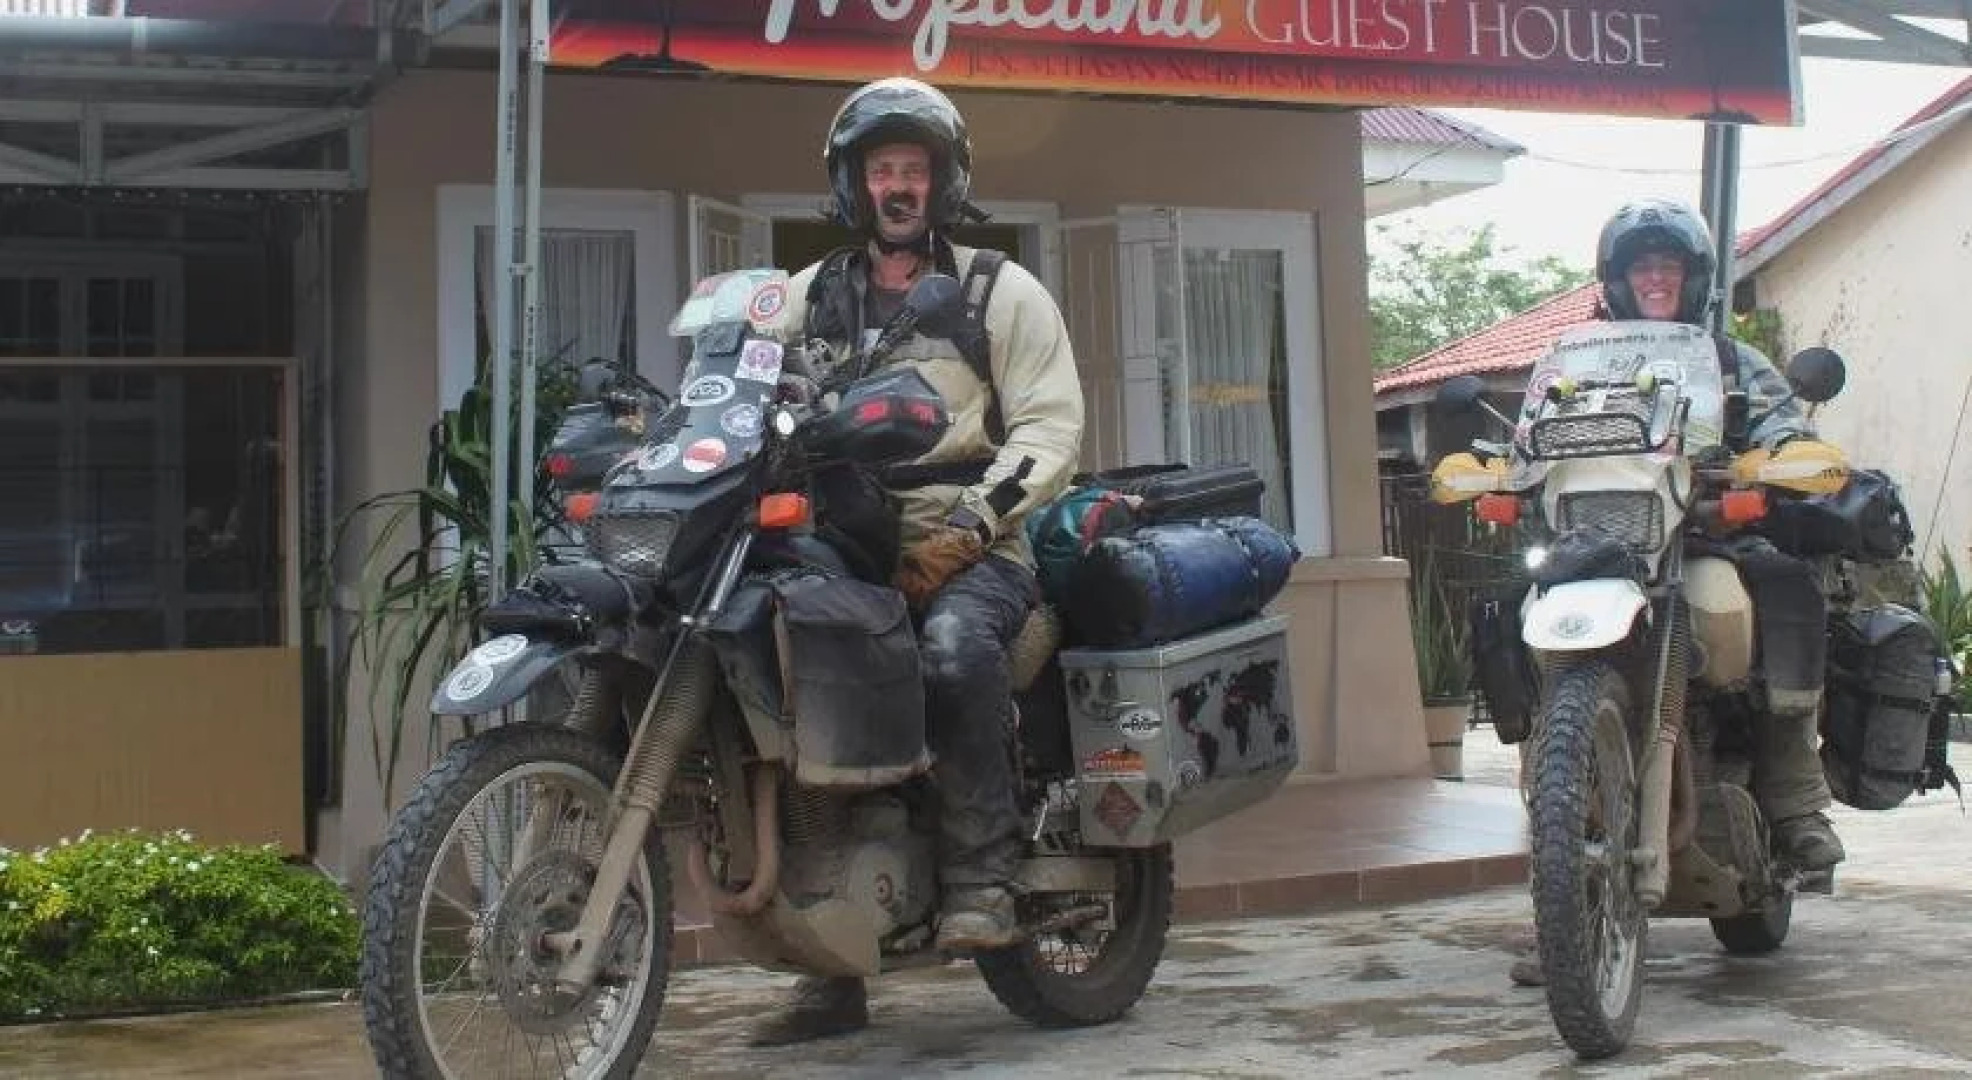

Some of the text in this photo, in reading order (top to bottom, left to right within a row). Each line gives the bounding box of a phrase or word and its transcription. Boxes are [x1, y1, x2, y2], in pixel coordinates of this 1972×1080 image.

[765, 0, 1664, 71] picana GUEST HOUSE
